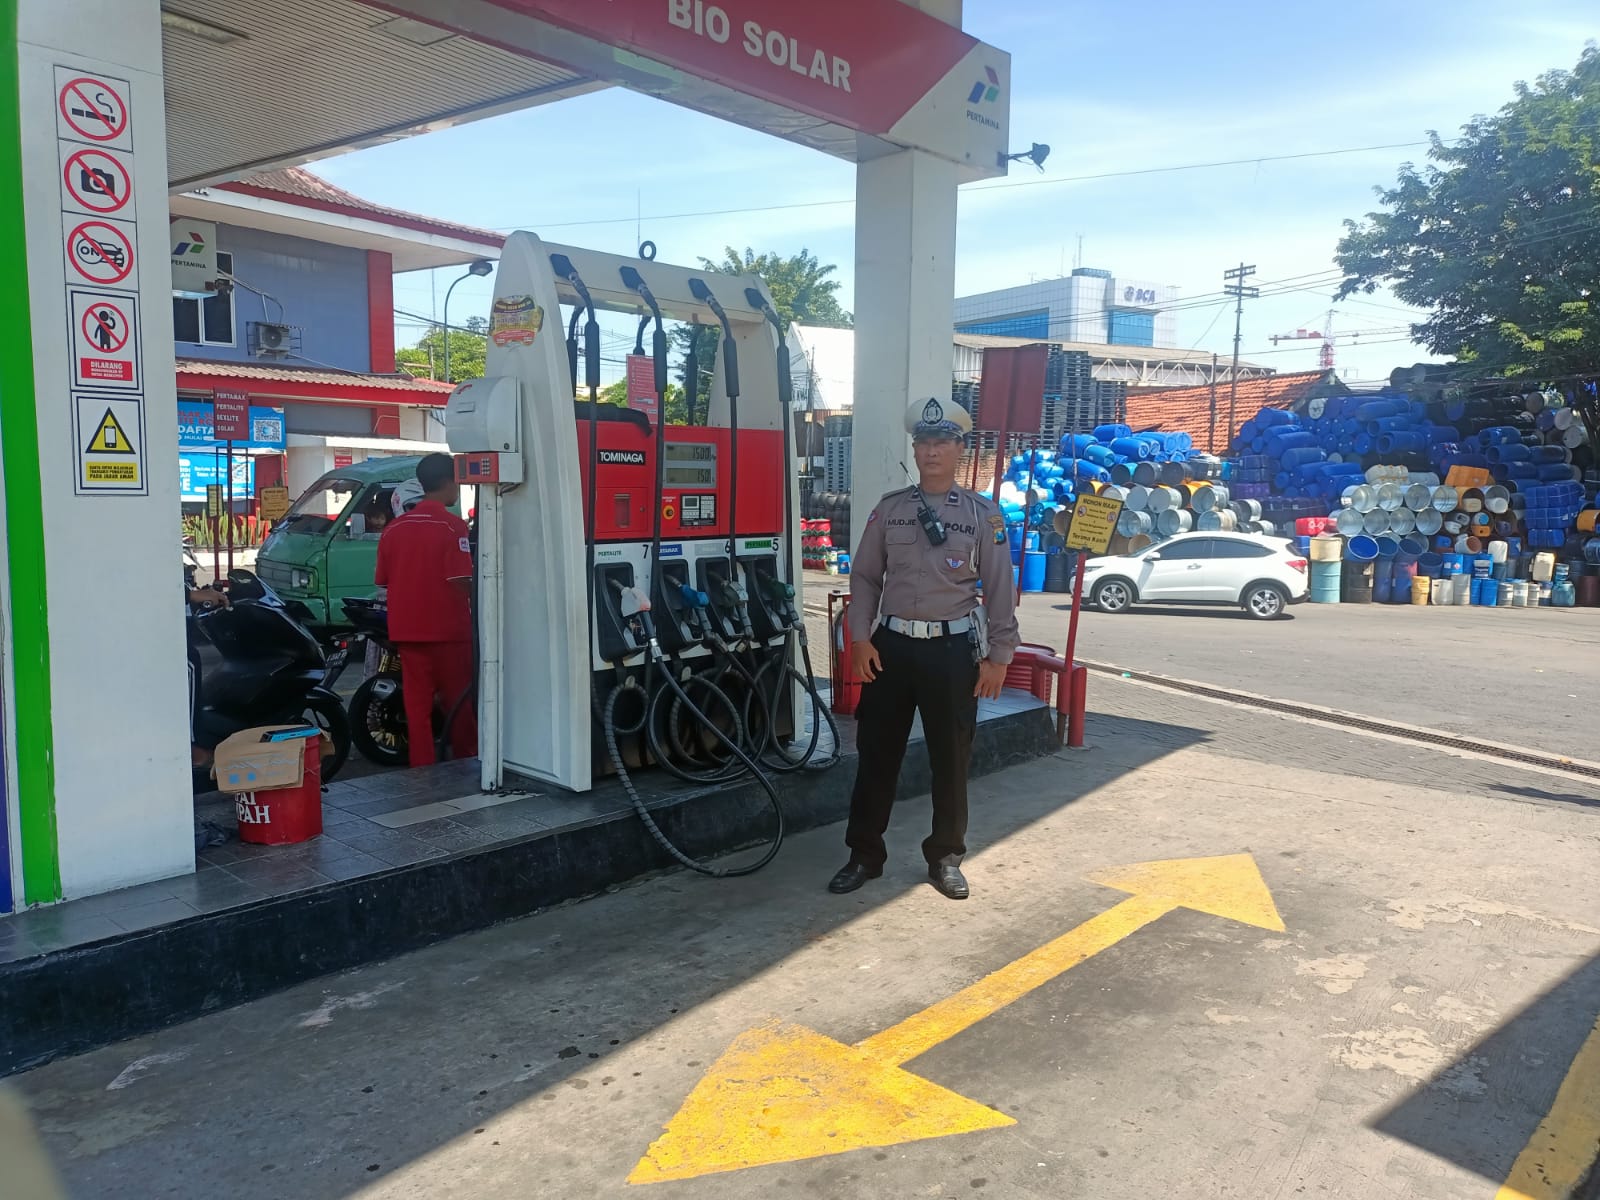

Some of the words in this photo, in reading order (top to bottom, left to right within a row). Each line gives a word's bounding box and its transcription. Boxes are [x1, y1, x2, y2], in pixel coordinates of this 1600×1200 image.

[668, 0, 730, 43] BIO
[743, 20, 851, 93] SOLAR
[966, 109, 1000, 130] PERTAMINA
[171, 259, 207, 270] PERTAMINA
[1135, 288, 1156, 303] BCA
[90, 360, 123, 370] DILARANG
[216, 392, 246, 401] PERTAMAX
[216, 403, 244, 411] PERTALITE
[216, 414, 239, 422] DEXLITE
[600, 451, 644, 463] TOMINAGA
[944, 522, 976, 536] POLRI
[725, 541, 731, 553] 6
[772, 538, 779, 552] 5
[642, 544, 649, 559] 7
